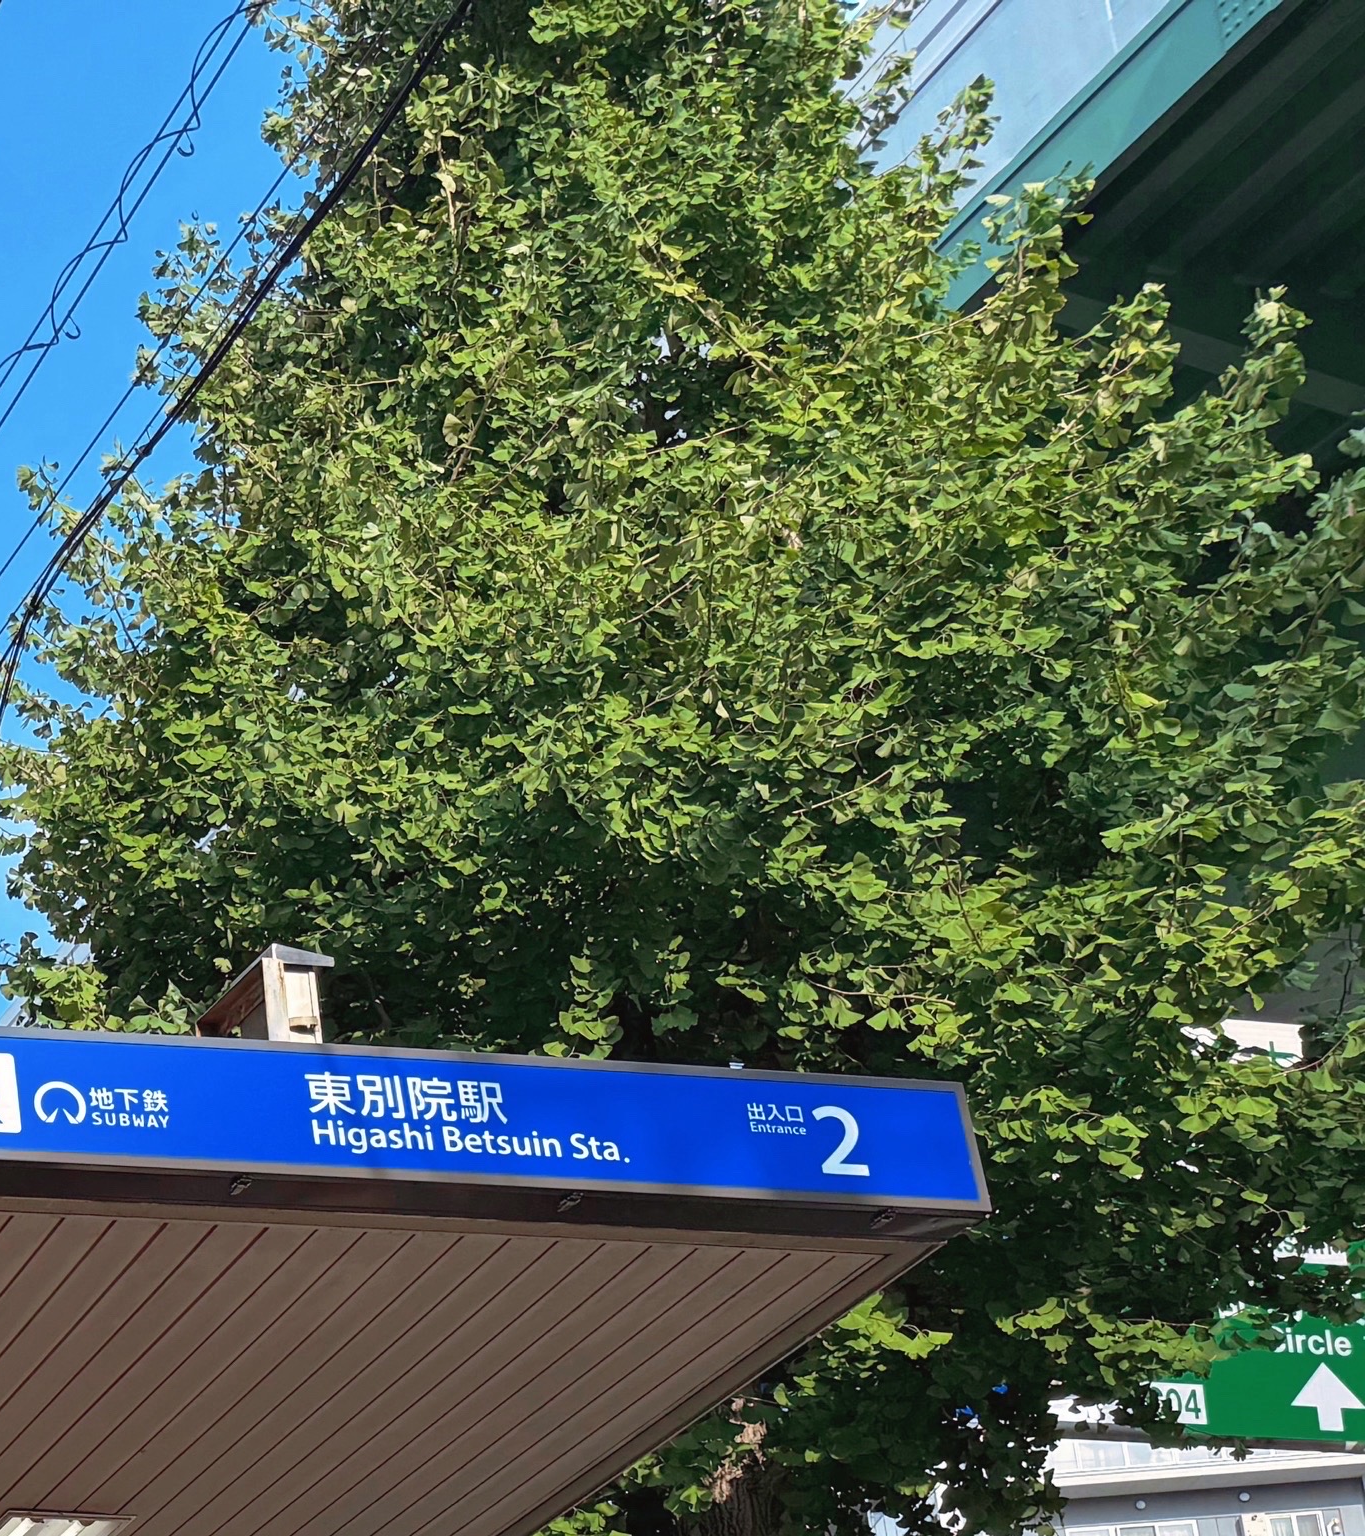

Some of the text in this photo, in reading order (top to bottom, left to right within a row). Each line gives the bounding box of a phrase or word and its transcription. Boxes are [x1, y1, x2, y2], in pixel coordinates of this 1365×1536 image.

[89, 1086, 169, 1112] 地下鉄
[305, 1071, 508, 1124] 東別院駅
[91, 1111, 170, 1129] SUBWAY
[746, 1102, 804, 1122] 出入口
[312, 1118, 630, 1164] Higashi Betsuin Sta.
[750, 1120, 807, 1136] Entrance
[812, 1105, 871, 1177] 2
